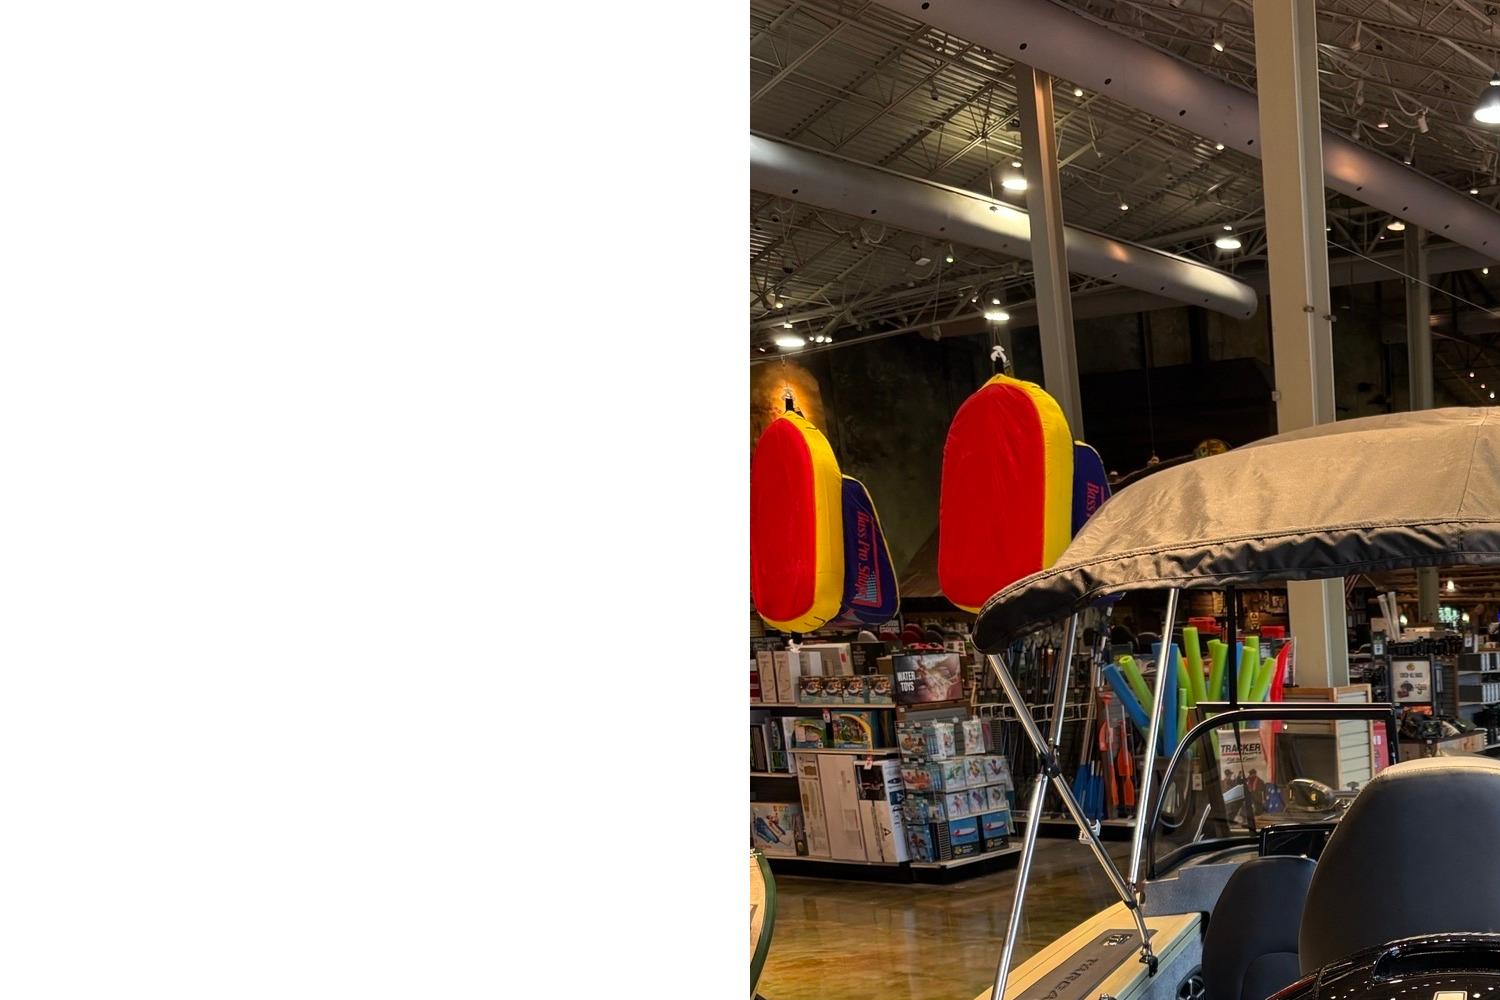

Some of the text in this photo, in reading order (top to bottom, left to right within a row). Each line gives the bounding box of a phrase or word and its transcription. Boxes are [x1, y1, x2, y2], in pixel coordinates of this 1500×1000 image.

[857, 511, 870, 538] Bass
[857, 539, 870, 561] Pro
[897, 671, 915, 681] WATER
[900, 681, 914, 692] TOYS
[1221, 743, 1261, 753] TRACKER
